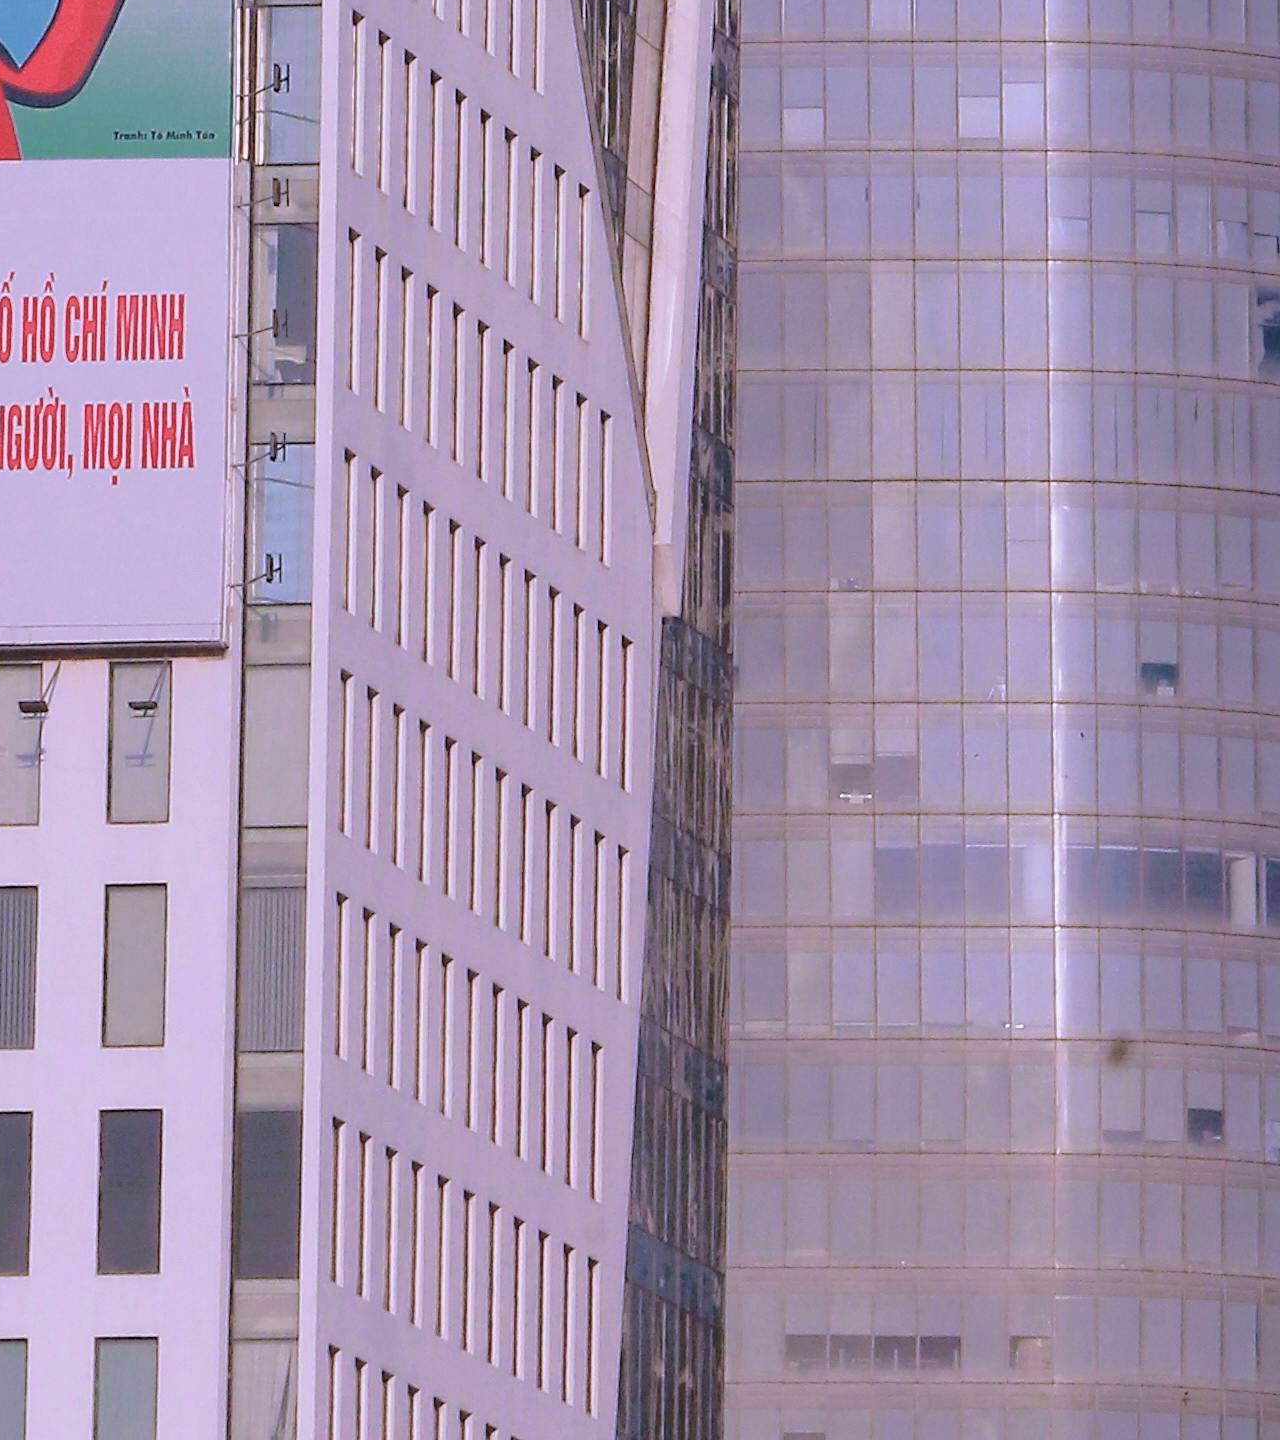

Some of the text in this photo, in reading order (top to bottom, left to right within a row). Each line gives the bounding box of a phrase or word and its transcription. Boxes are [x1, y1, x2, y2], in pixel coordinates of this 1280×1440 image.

[21, 272, 56, 363] HỒ
[64, 279, 108, 363] CHÍ
[116, 293, 185, 361] MINH
[83, 401, 132, 486] MỌI
[141, 386, 195, 469] NHÀ
